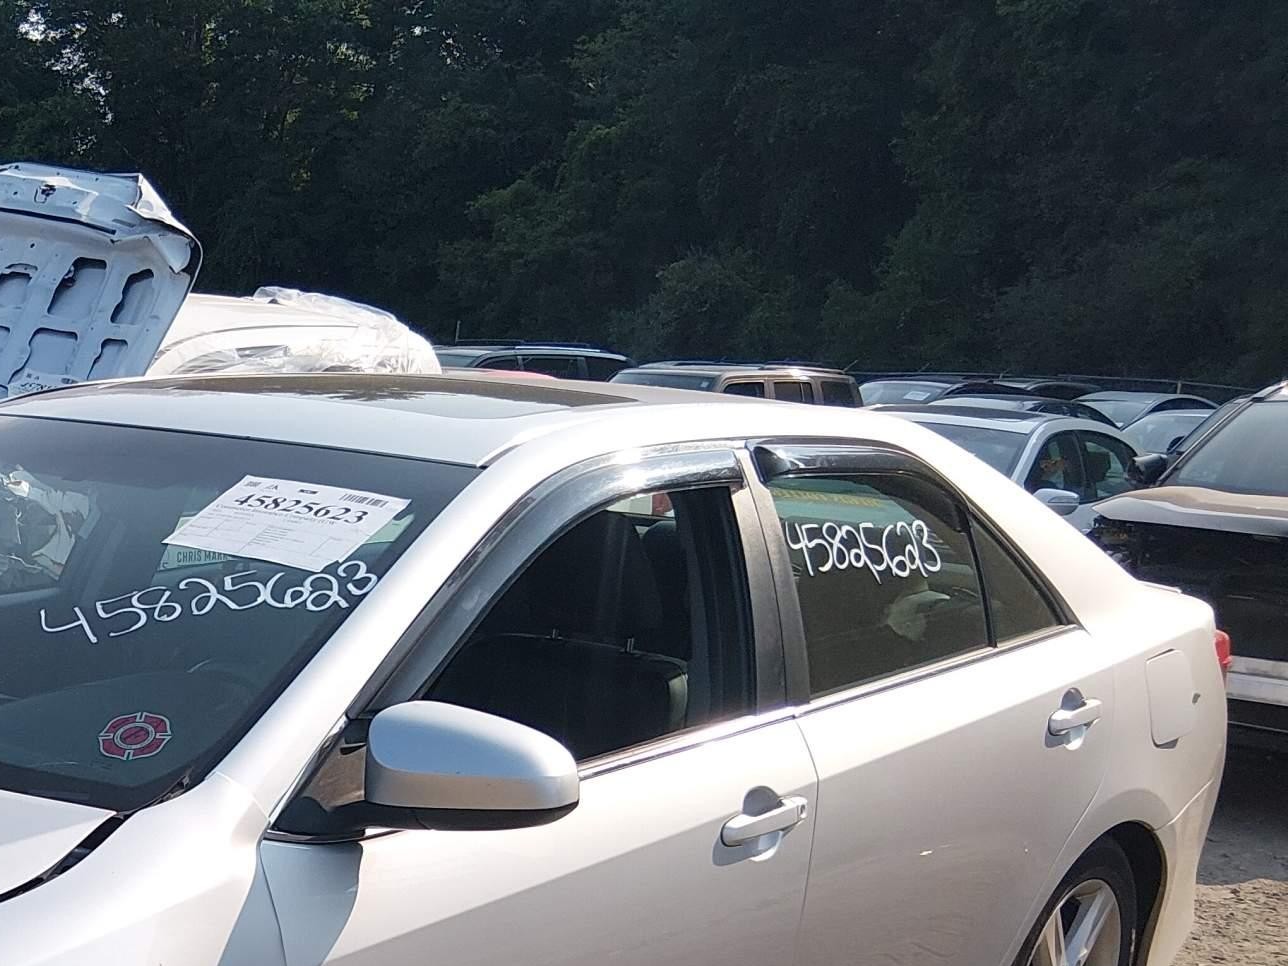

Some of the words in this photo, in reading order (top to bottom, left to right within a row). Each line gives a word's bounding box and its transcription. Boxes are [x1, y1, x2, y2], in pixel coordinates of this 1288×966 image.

[234, 493, 369, 524] 45825623
[176, 550, 202, 563] CHRIS
[785, 520, 942, 584] 45825623
[39, 560, 378, 643] 45825623
